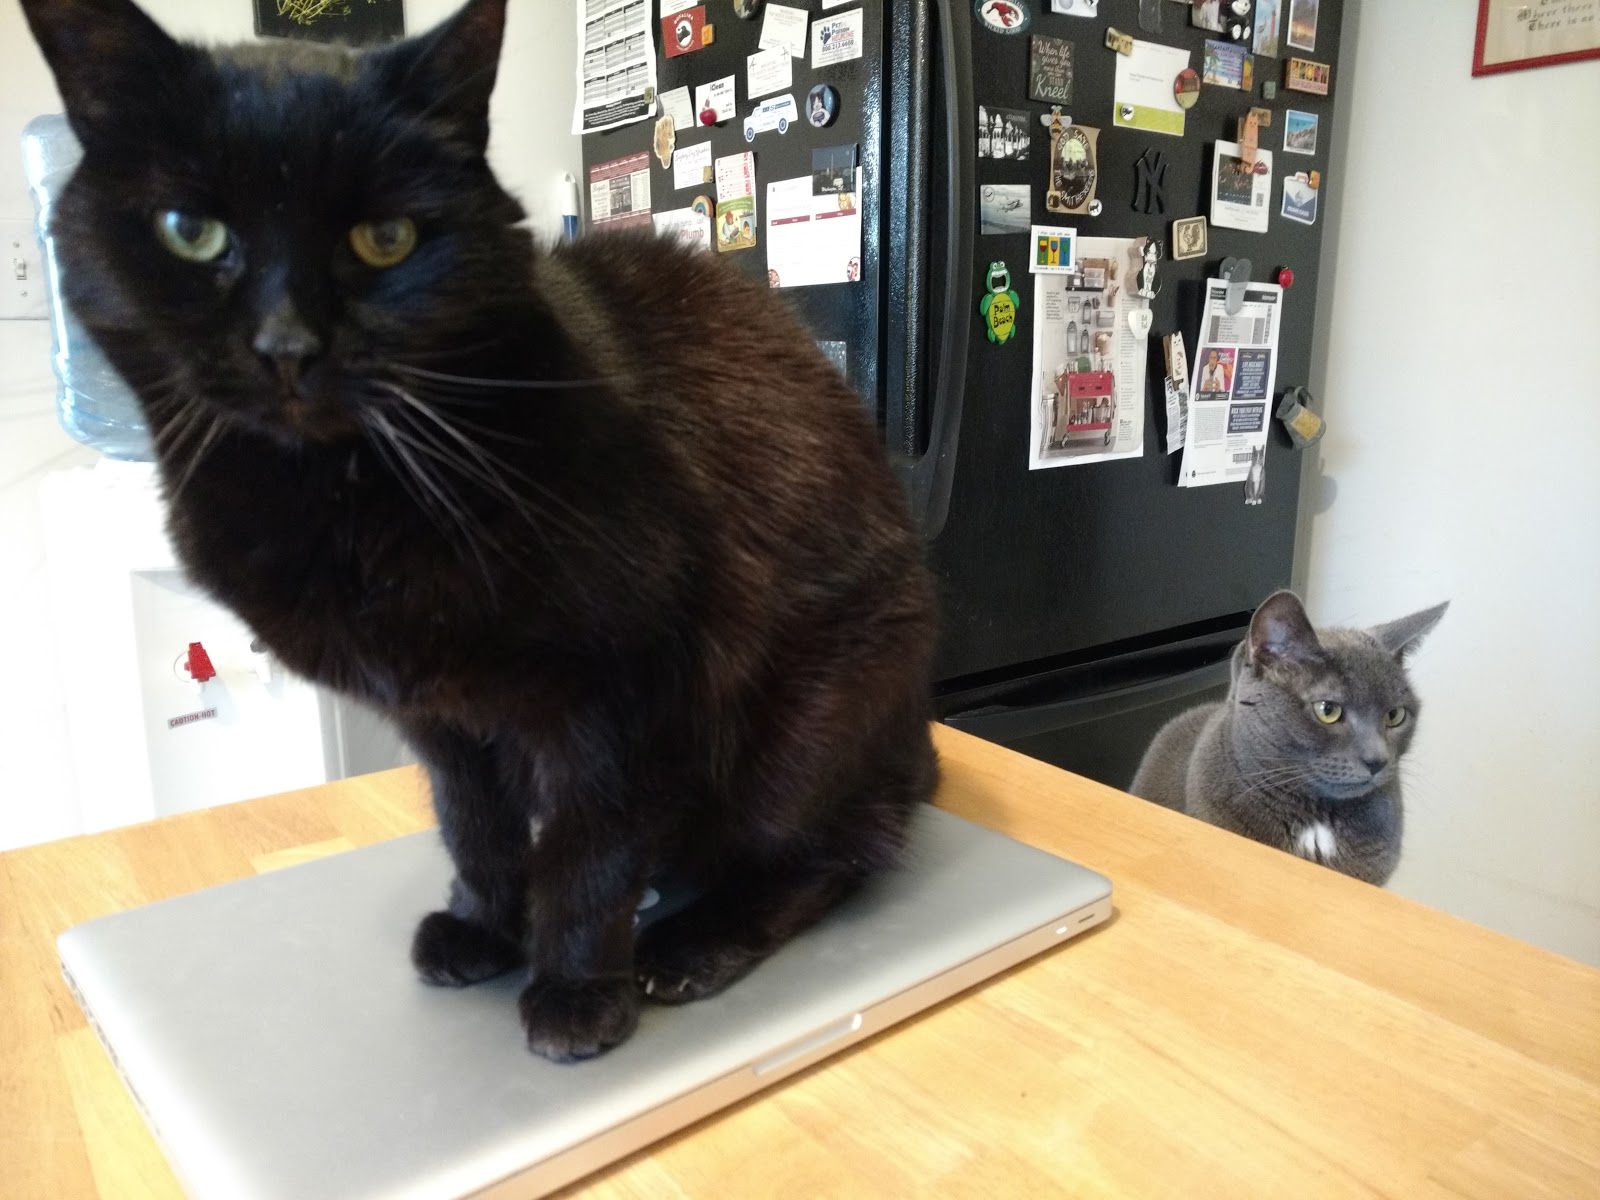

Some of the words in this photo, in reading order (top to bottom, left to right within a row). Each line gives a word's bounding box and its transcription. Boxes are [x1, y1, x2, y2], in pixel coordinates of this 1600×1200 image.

[1038, 40, 1058, 56] When
[1059, 45, 1070, 60] life
[1041, 56, 1058, 66] gives
[1059, 59, 1071, 68] you
[1035, 74, 1071, 100] Kneel
[1057, 132, 1070, 150] GOD
[993, 303, 1011, 316] Palm
[993, 314, 1013, 329] Beach
[170, 709, 216, 727] CAUTION-HOT
